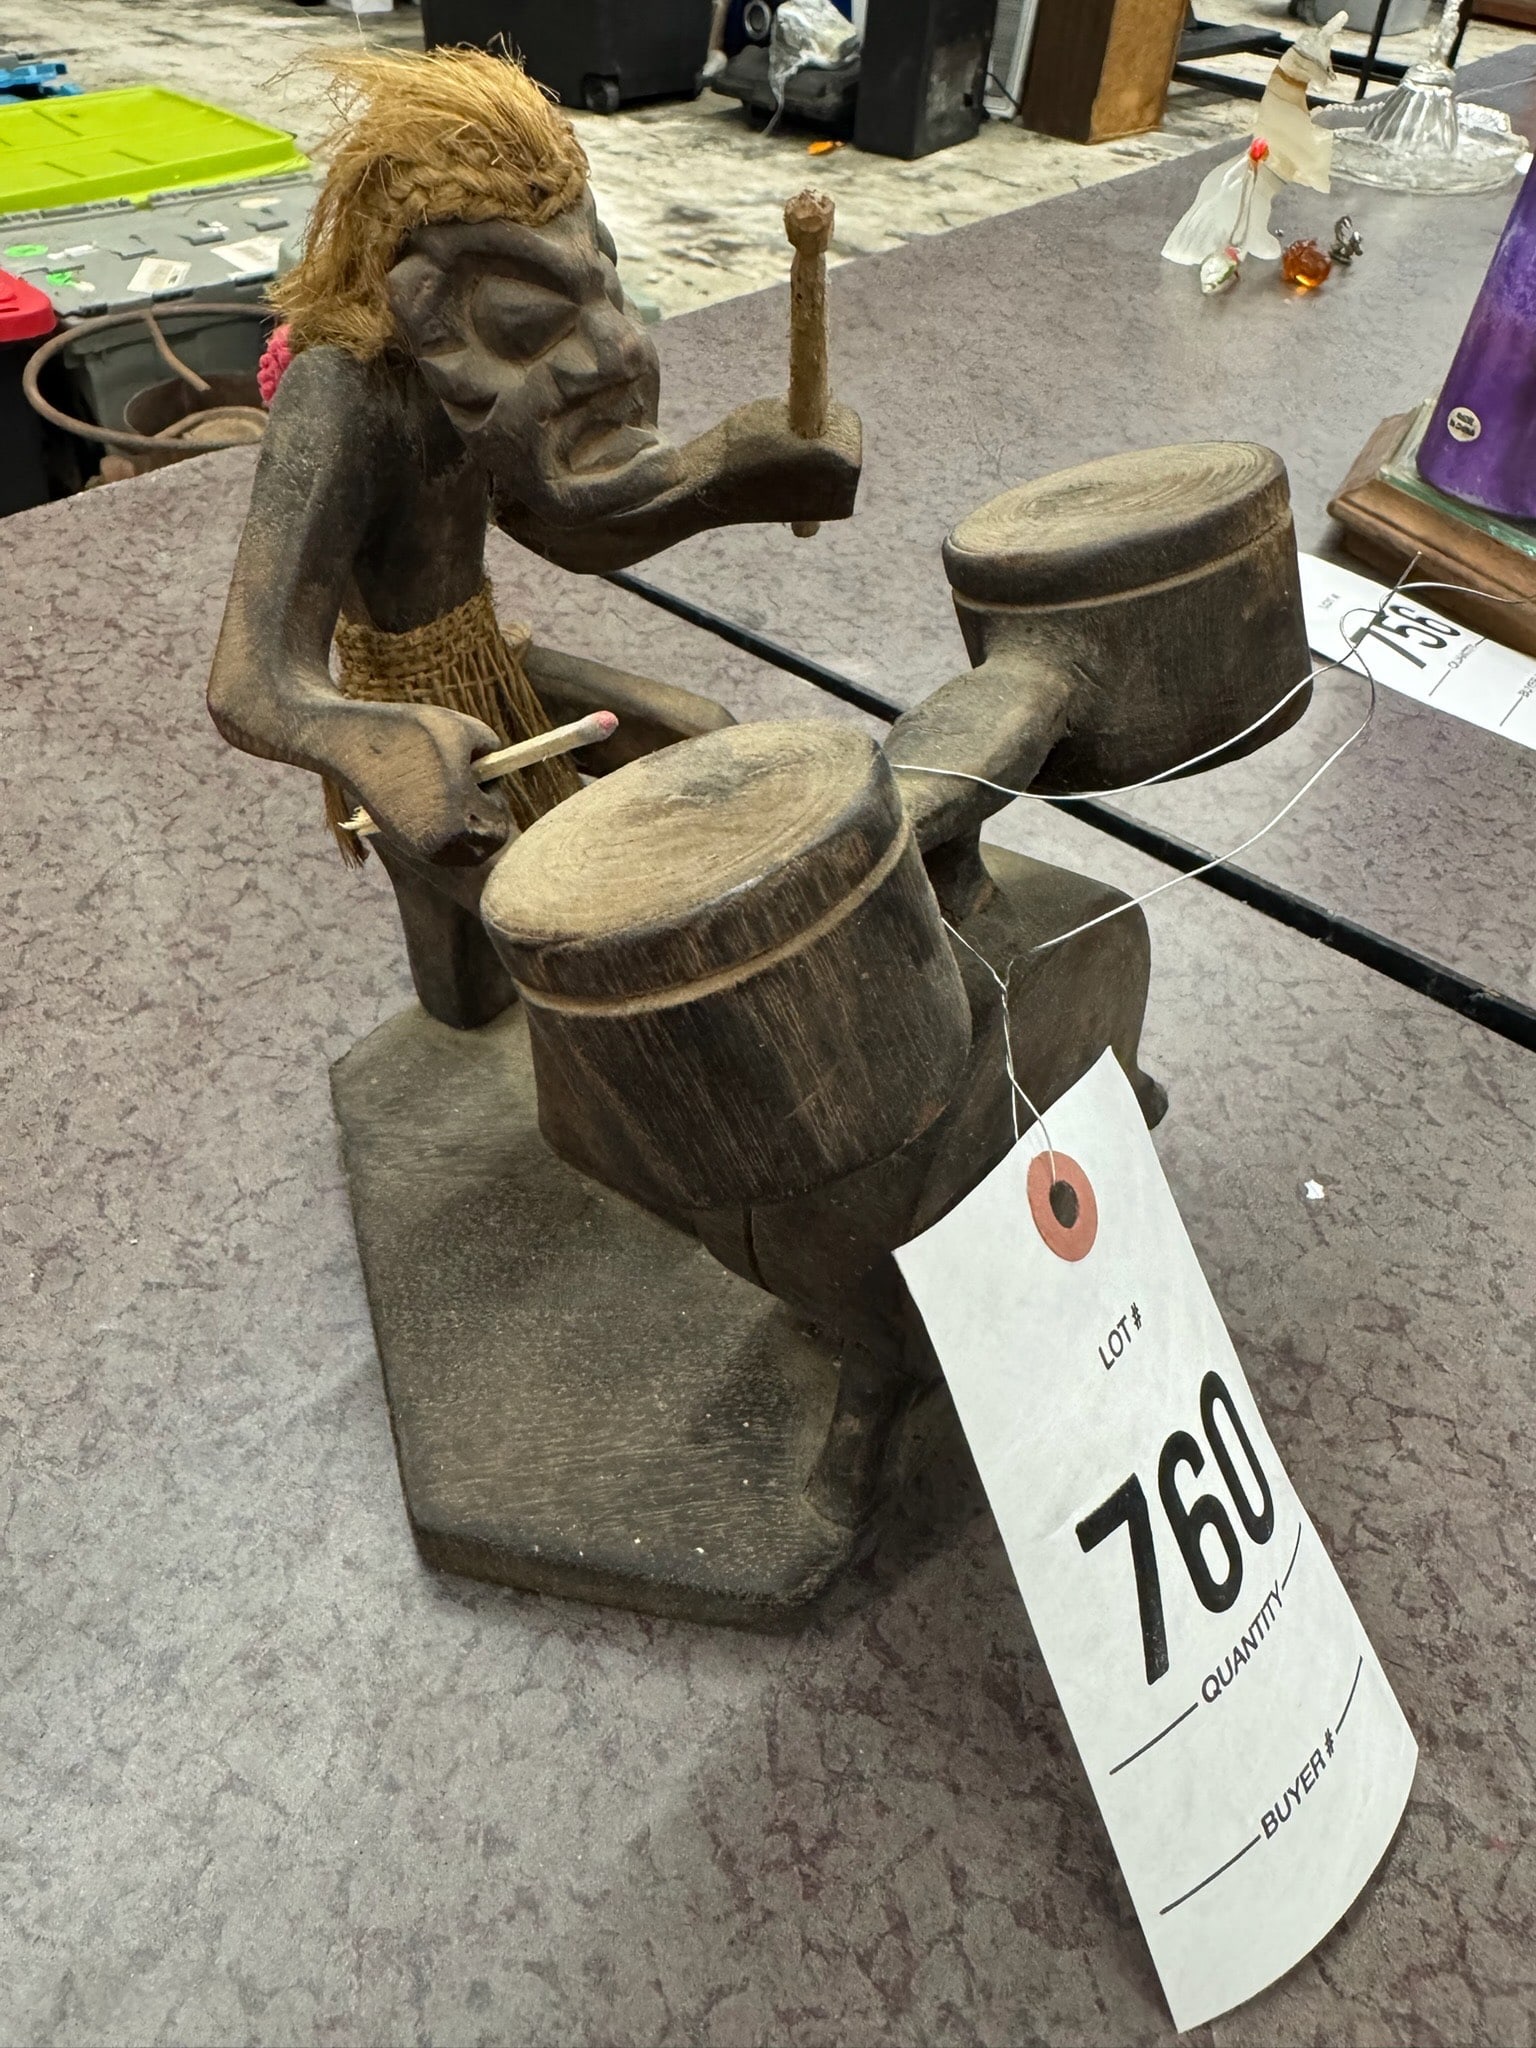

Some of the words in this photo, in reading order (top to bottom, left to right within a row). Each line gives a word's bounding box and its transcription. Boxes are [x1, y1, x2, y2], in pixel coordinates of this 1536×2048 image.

[1349, 604, 1461, 670] 756
[1098, 1314, 1132, 1371] LOT
[1130, 1301, 1142, 1331] #
[1075, 1370, 1275, 1686] 760
[1201, 1578, 1283, 1704] QUANTITY
[1260, 1747, 1327, 1840] BUYER
[1324, 1727, 1335, 1759] #
